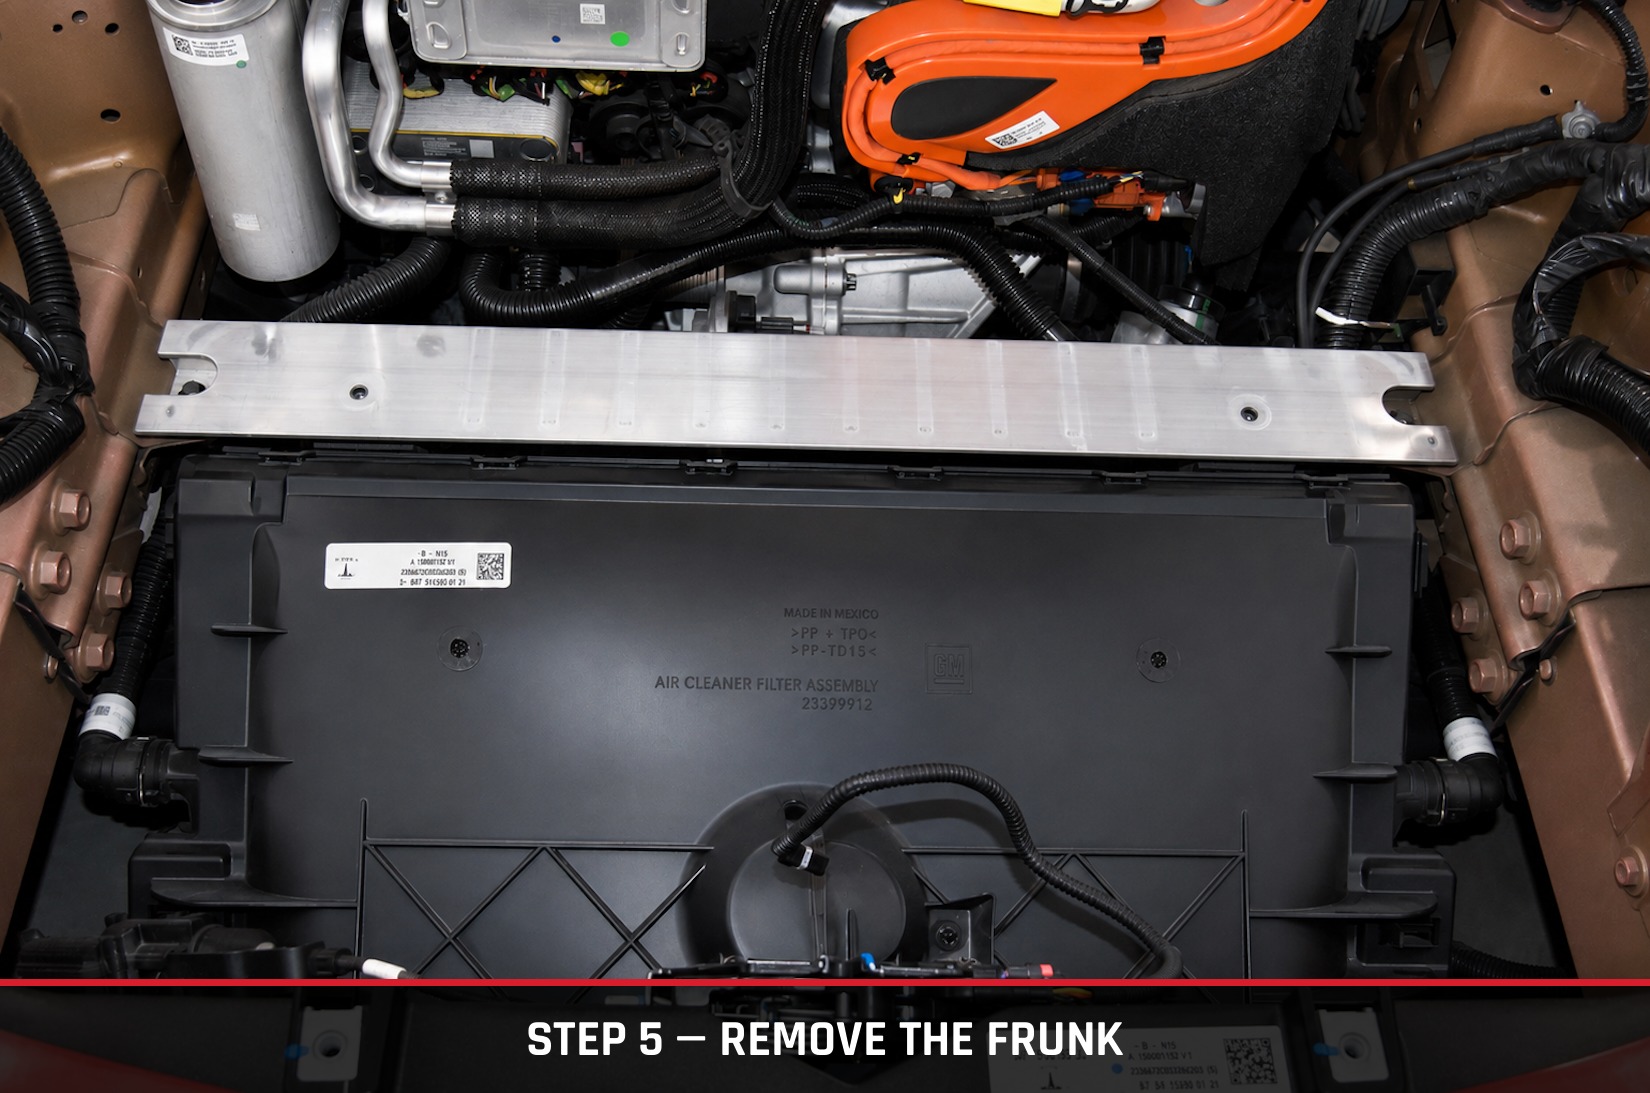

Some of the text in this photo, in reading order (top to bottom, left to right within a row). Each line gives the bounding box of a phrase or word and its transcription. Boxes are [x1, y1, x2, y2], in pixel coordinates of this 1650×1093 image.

[783, 608, 880, 620] MADE IN MEXICO
[791, 628, 818, 640] >PP
[840, 628, 877, 640] TPO<
[791, 645, 877, 657] >PP-TD15<
[933, 653, 965, 678] GM
[654, 676, 879, 693] AIR CLEANER FILTER ASSEMBLY
[801, 697, 873, 711] 23399912
[1161, 1041, 1177, 1050] N15
